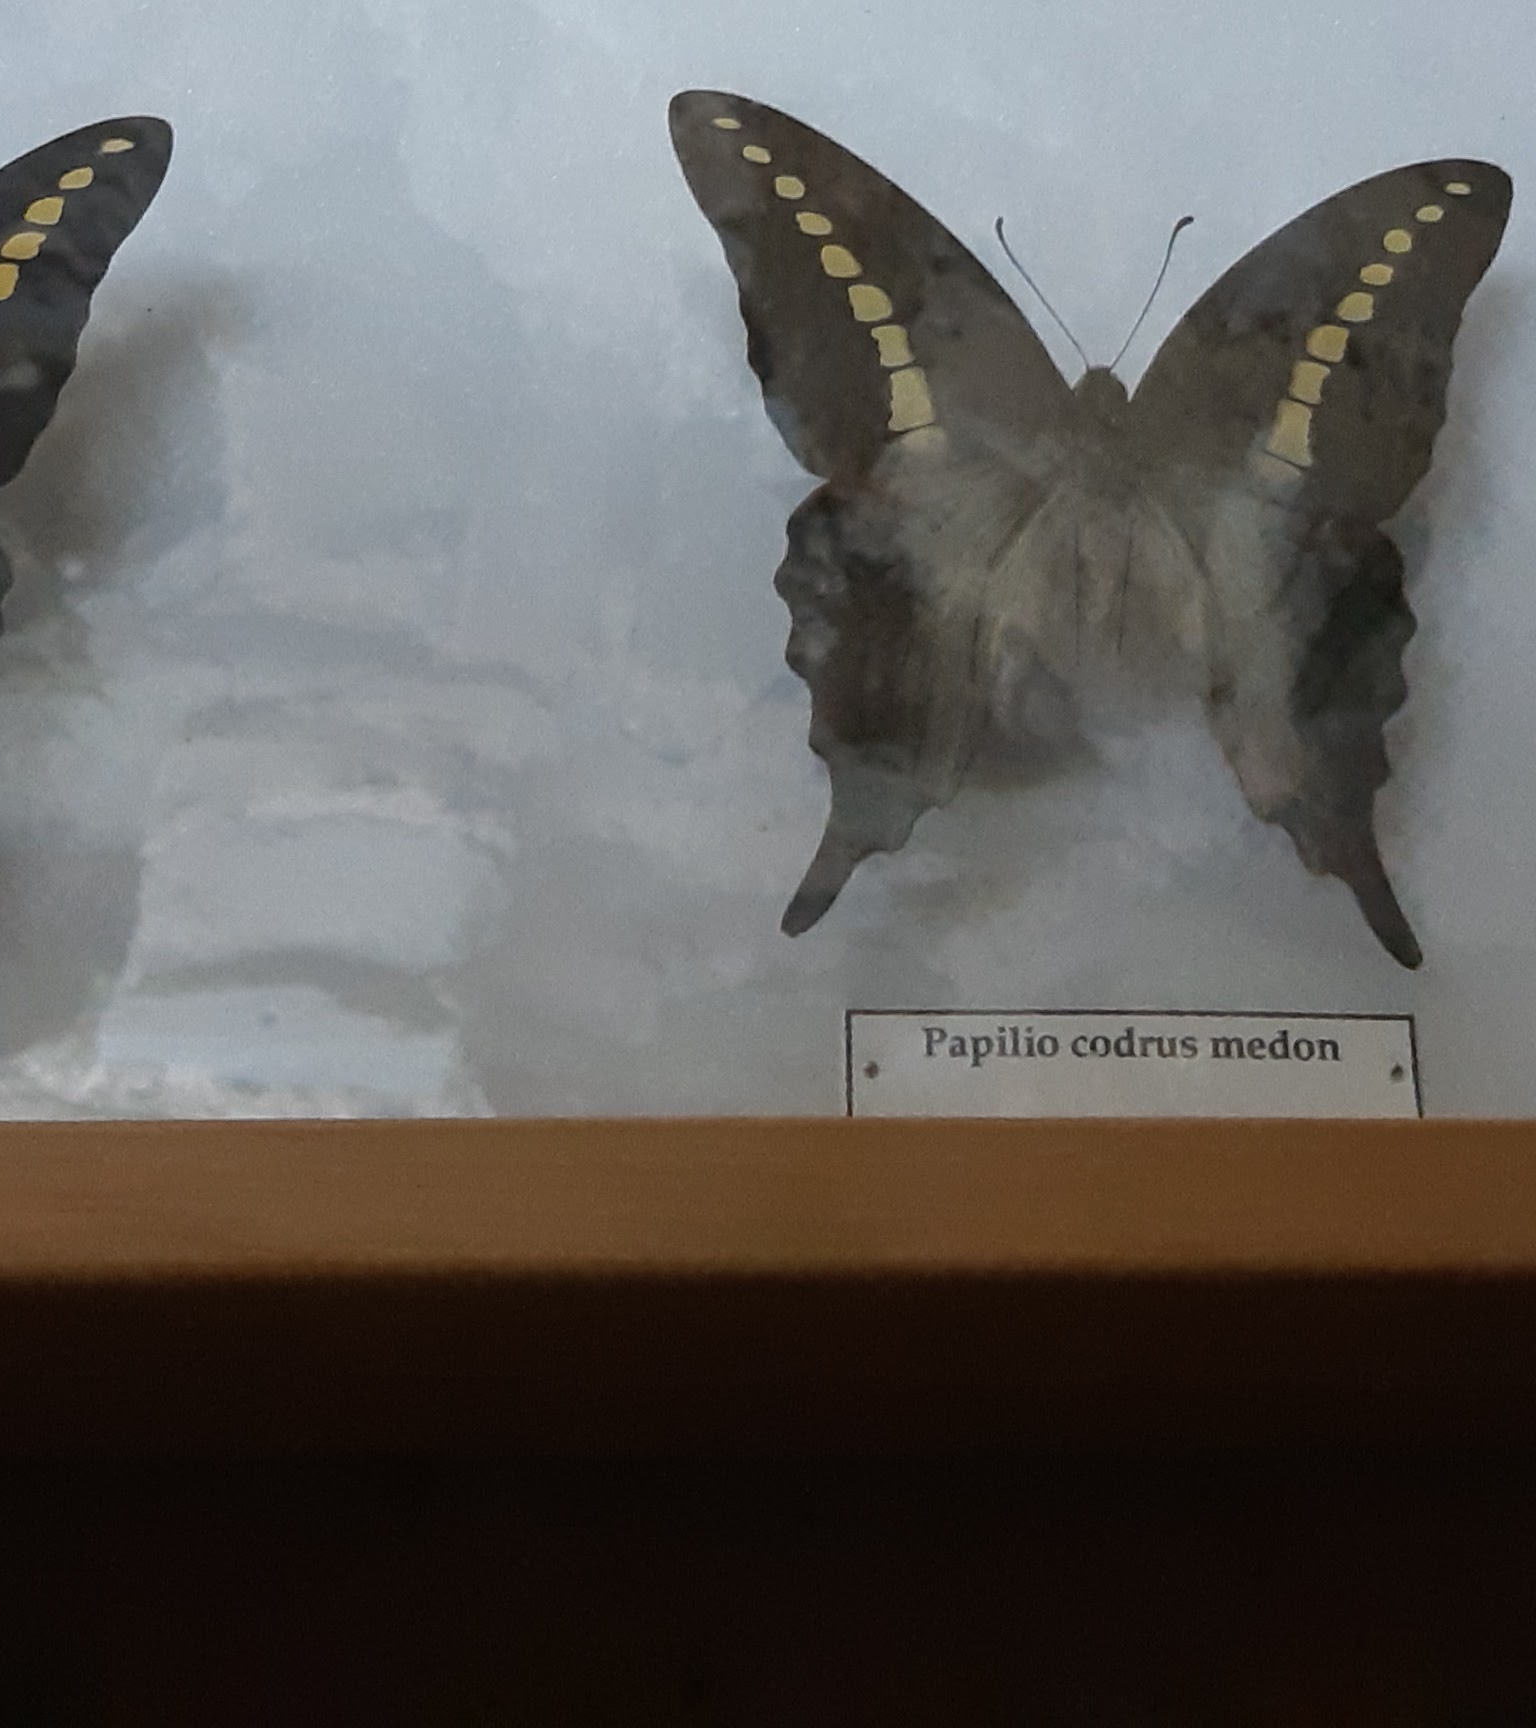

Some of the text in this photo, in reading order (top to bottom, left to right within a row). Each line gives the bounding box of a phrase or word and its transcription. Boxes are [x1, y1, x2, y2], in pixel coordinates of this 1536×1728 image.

[923, 1026, 1341, 1068] Papilio codrus medon
